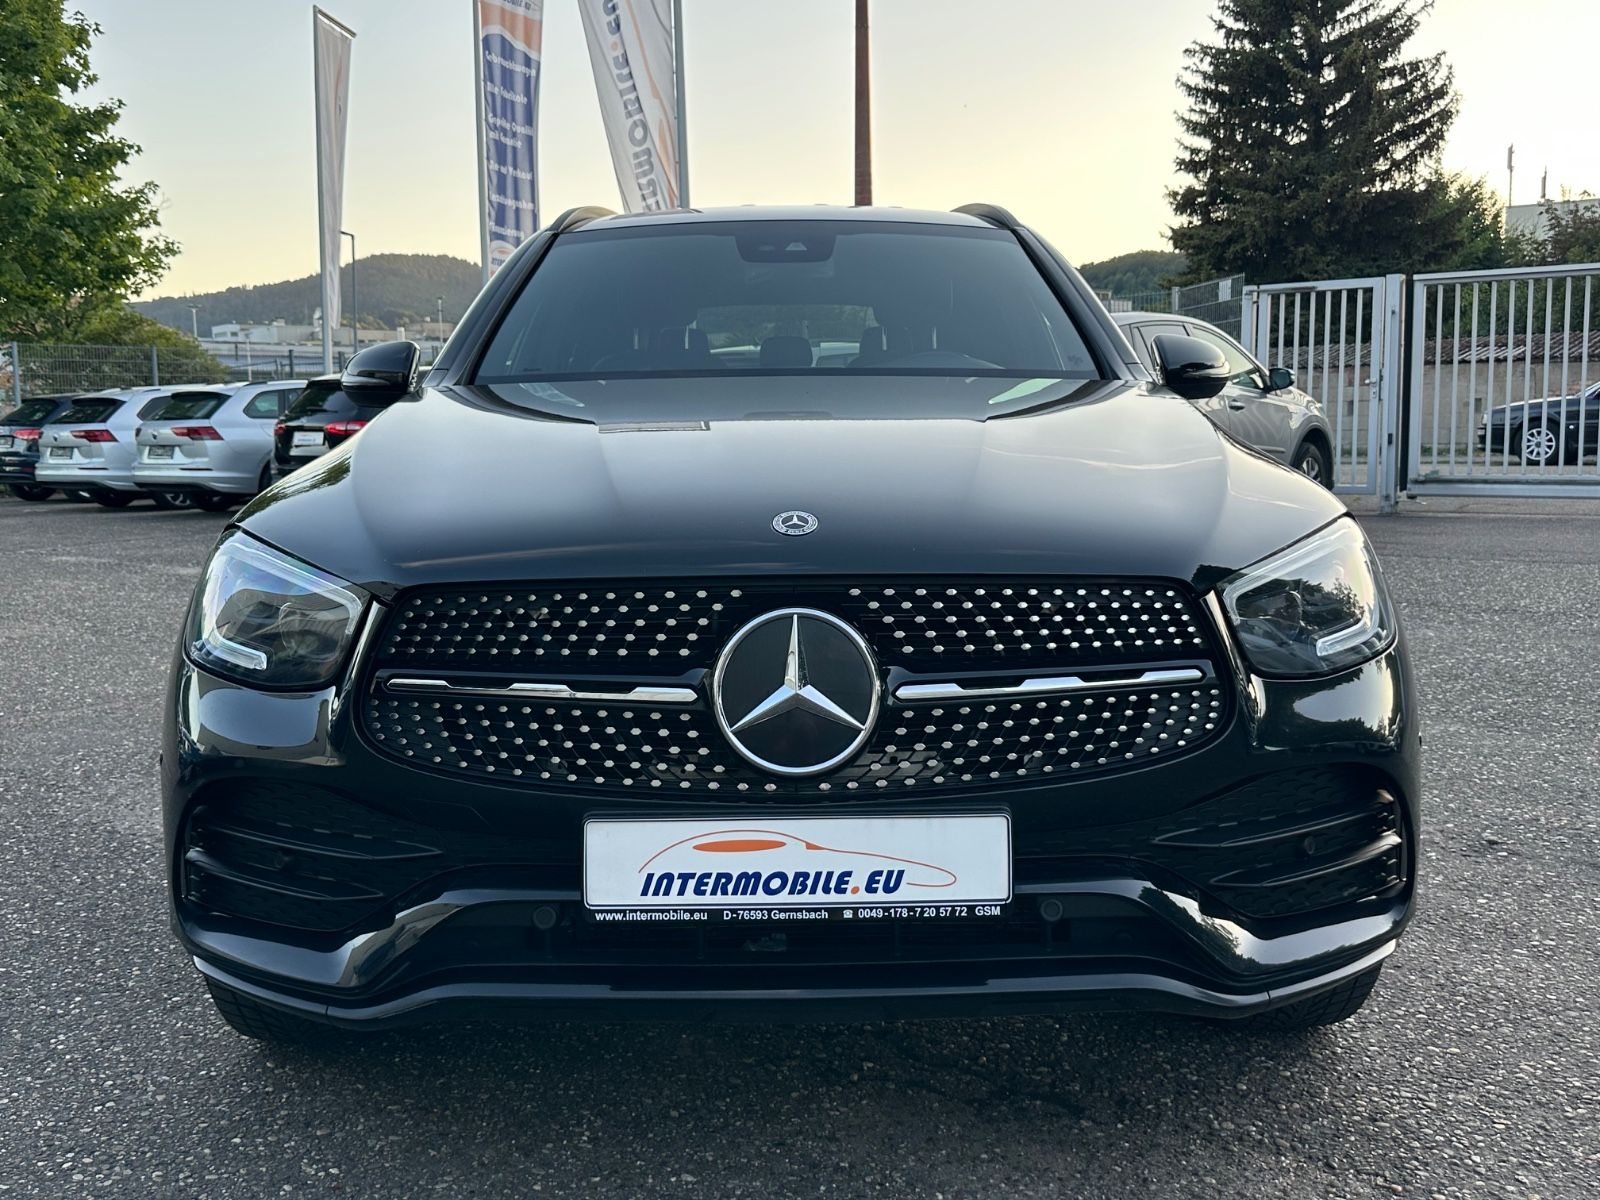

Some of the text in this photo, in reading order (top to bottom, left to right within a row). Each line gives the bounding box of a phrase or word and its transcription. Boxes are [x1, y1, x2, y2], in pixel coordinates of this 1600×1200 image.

[640, 869, 905, 897] INTERMOBILE.EU
[595, 910, 708, 921] www.intermobile.eu
[723, 910, 768, 920] D-76593
[771, 909, 828, 919] Gernsbach
[975, 905, 1001, 916] GSM
